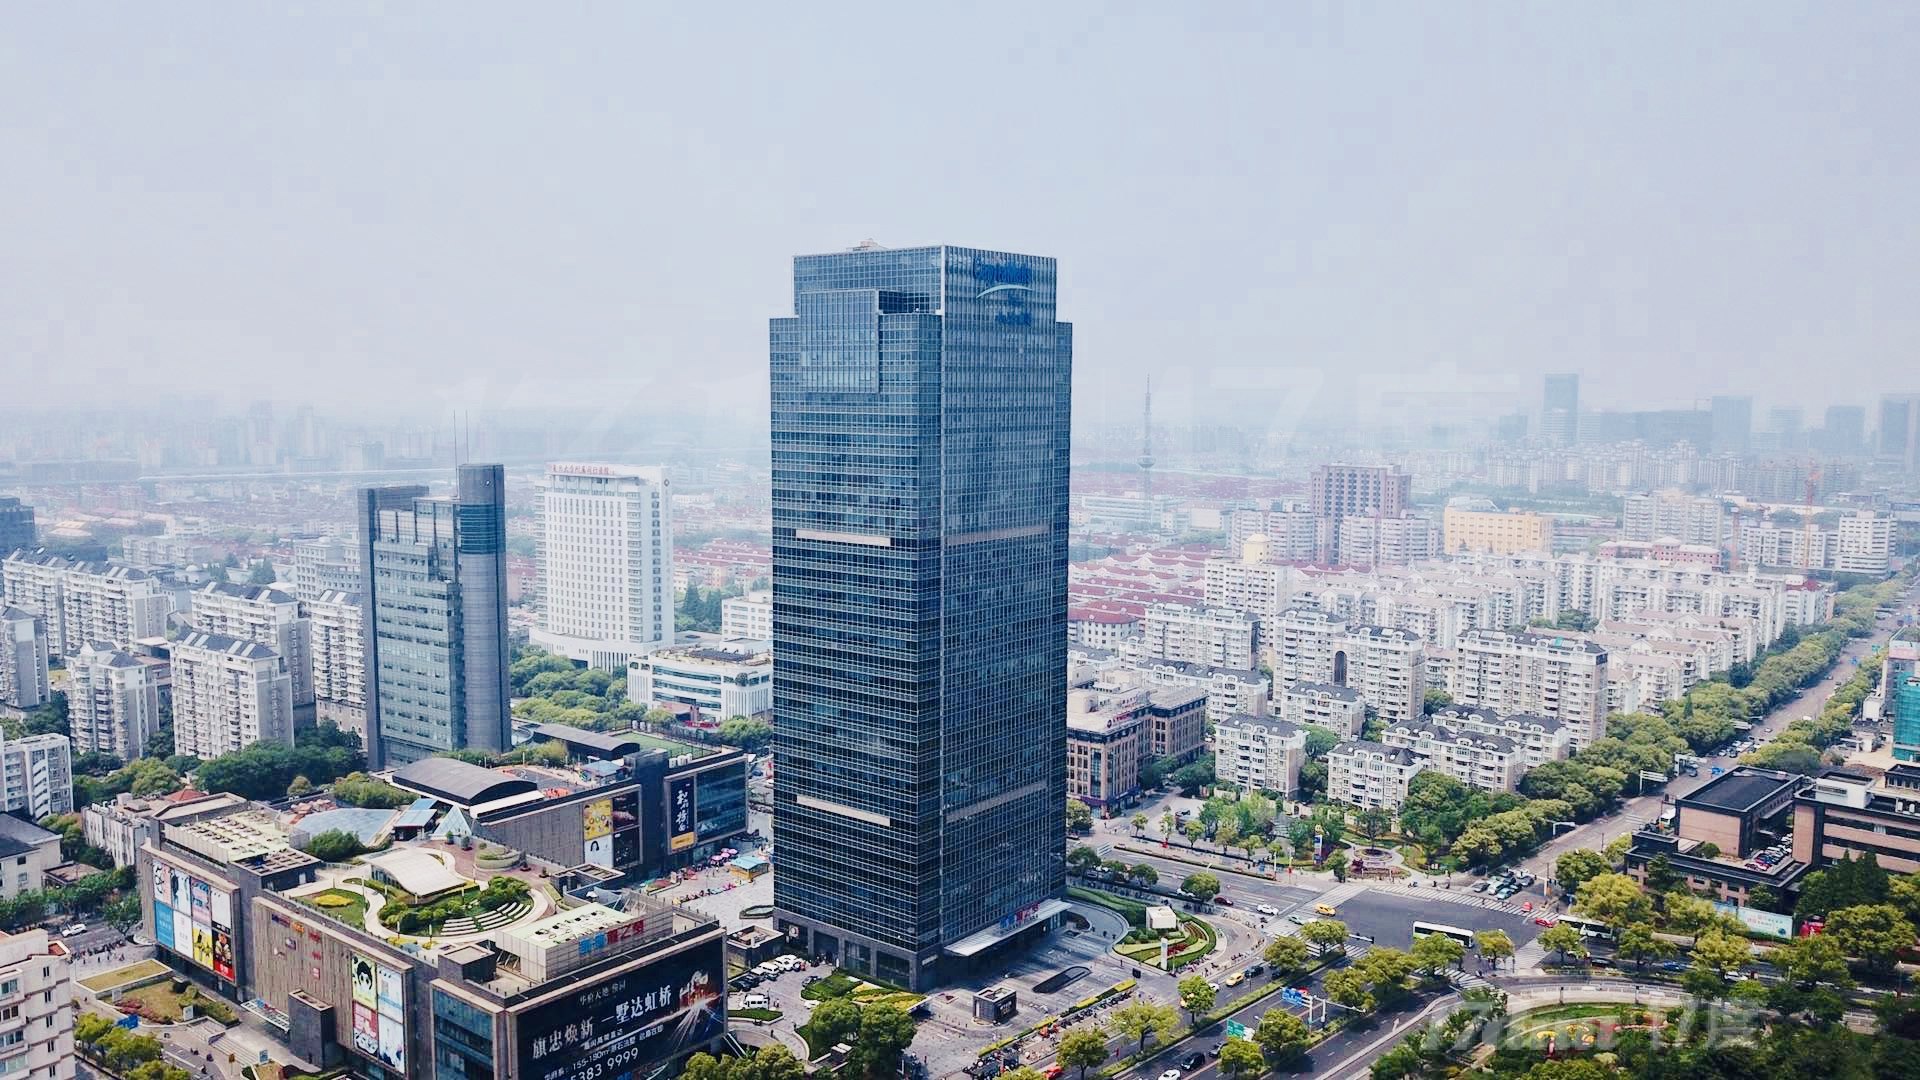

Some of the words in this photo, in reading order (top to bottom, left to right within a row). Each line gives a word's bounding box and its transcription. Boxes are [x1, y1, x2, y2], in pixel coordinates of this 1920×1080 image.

[532, 1016, 593, 1059] 旗忠焕新
[601, 985, 672, 1024] 一墅达虹桥
[607, 1047, 639, 1070] 9999
